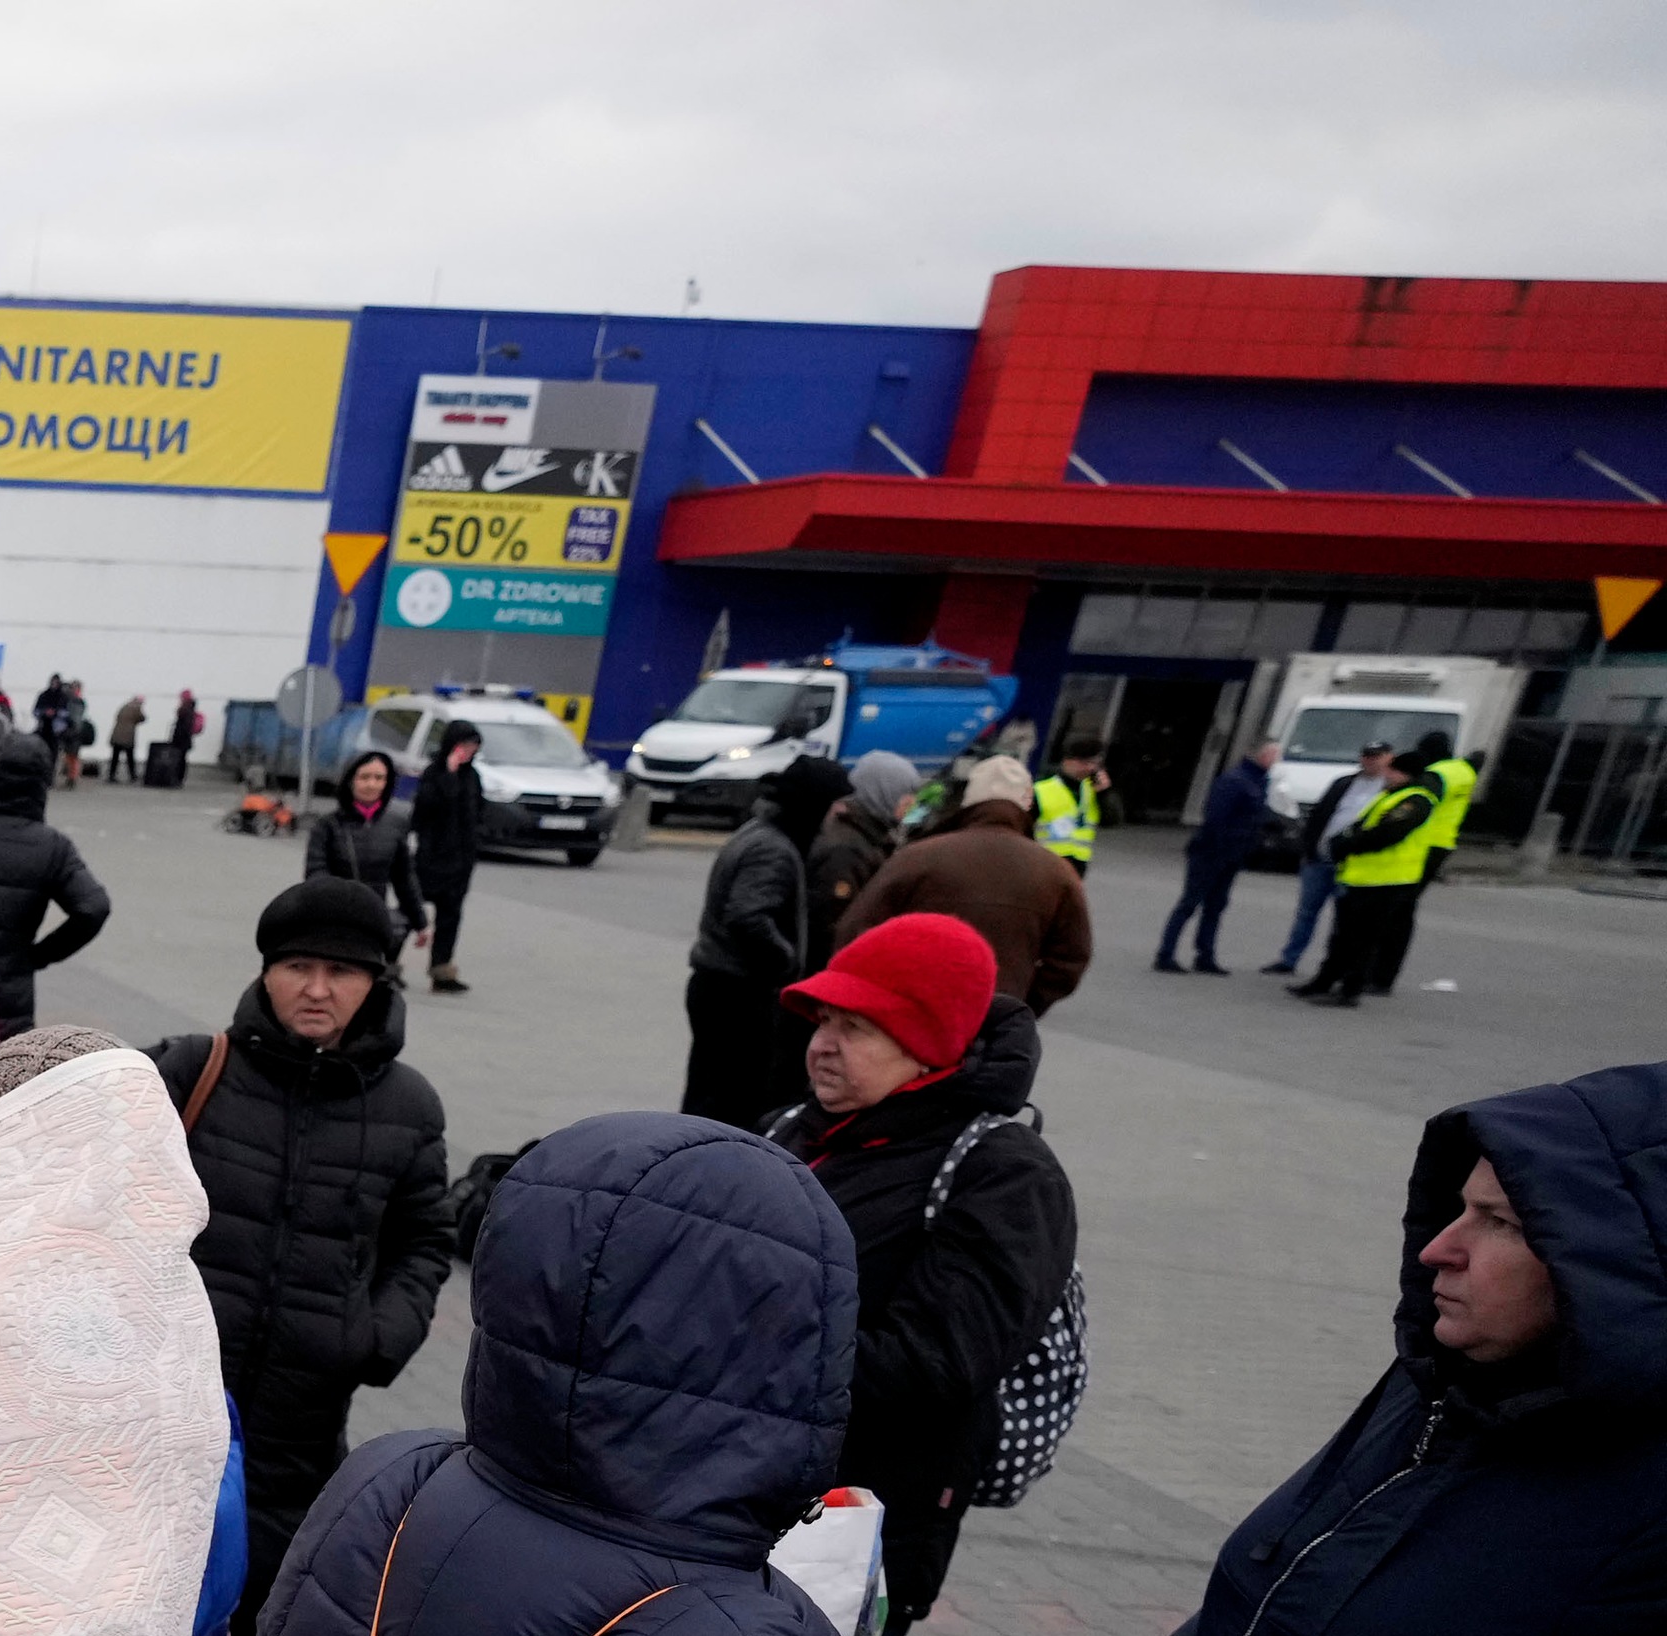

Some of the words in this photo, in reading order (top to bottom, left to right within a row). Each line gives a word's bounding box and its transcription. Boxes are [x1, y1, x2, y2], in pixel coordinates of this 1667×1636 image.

[409, 514, 528, 562] -50%
[461, 579, 496, 599] DR
[498, 580, 607, 605] ZDROWIE
[494, 608, 564, 625] APTEKA
